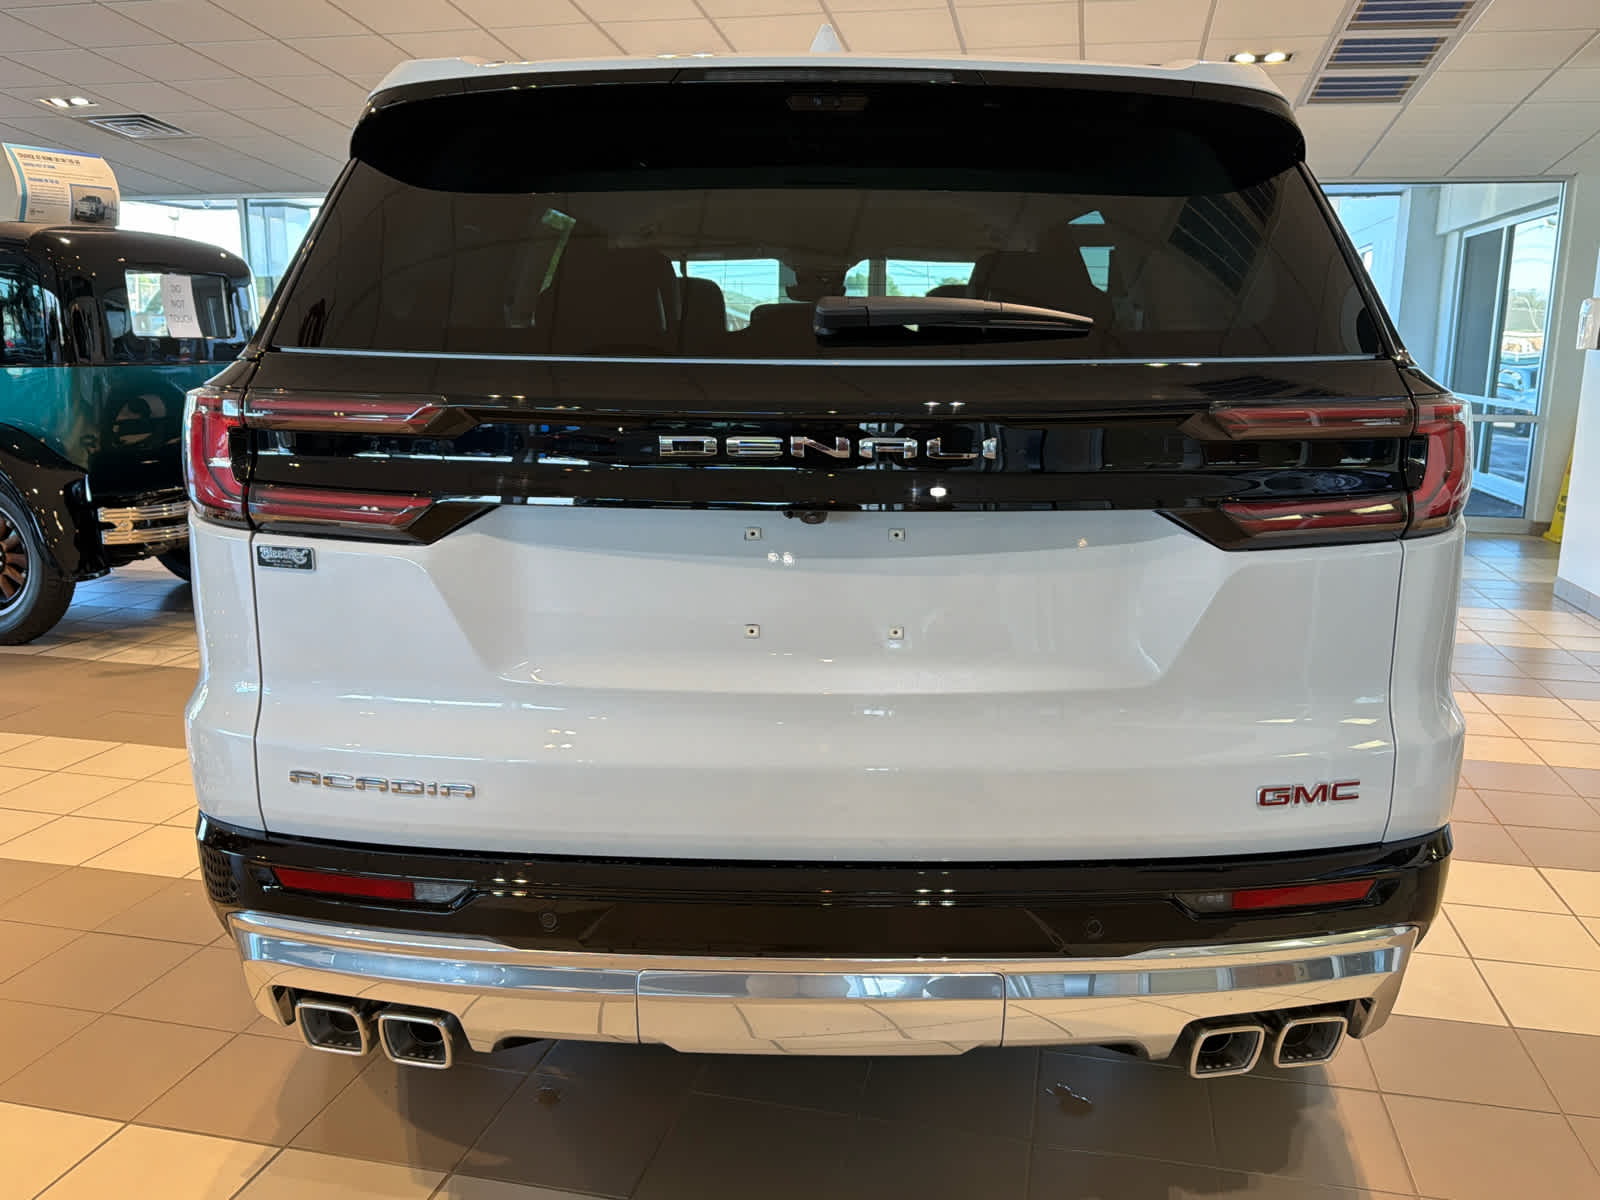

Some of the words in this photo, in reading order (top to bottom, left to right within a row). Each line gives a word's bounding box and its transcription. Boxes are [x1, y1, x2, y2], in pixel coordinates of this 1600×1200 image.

[170, 299, 185, 310] NOT
[658, 435, 998, 459] DENALI
[289, 769, 476, 799] ACADIA
[1256, 778, 1361, 807] GMC
